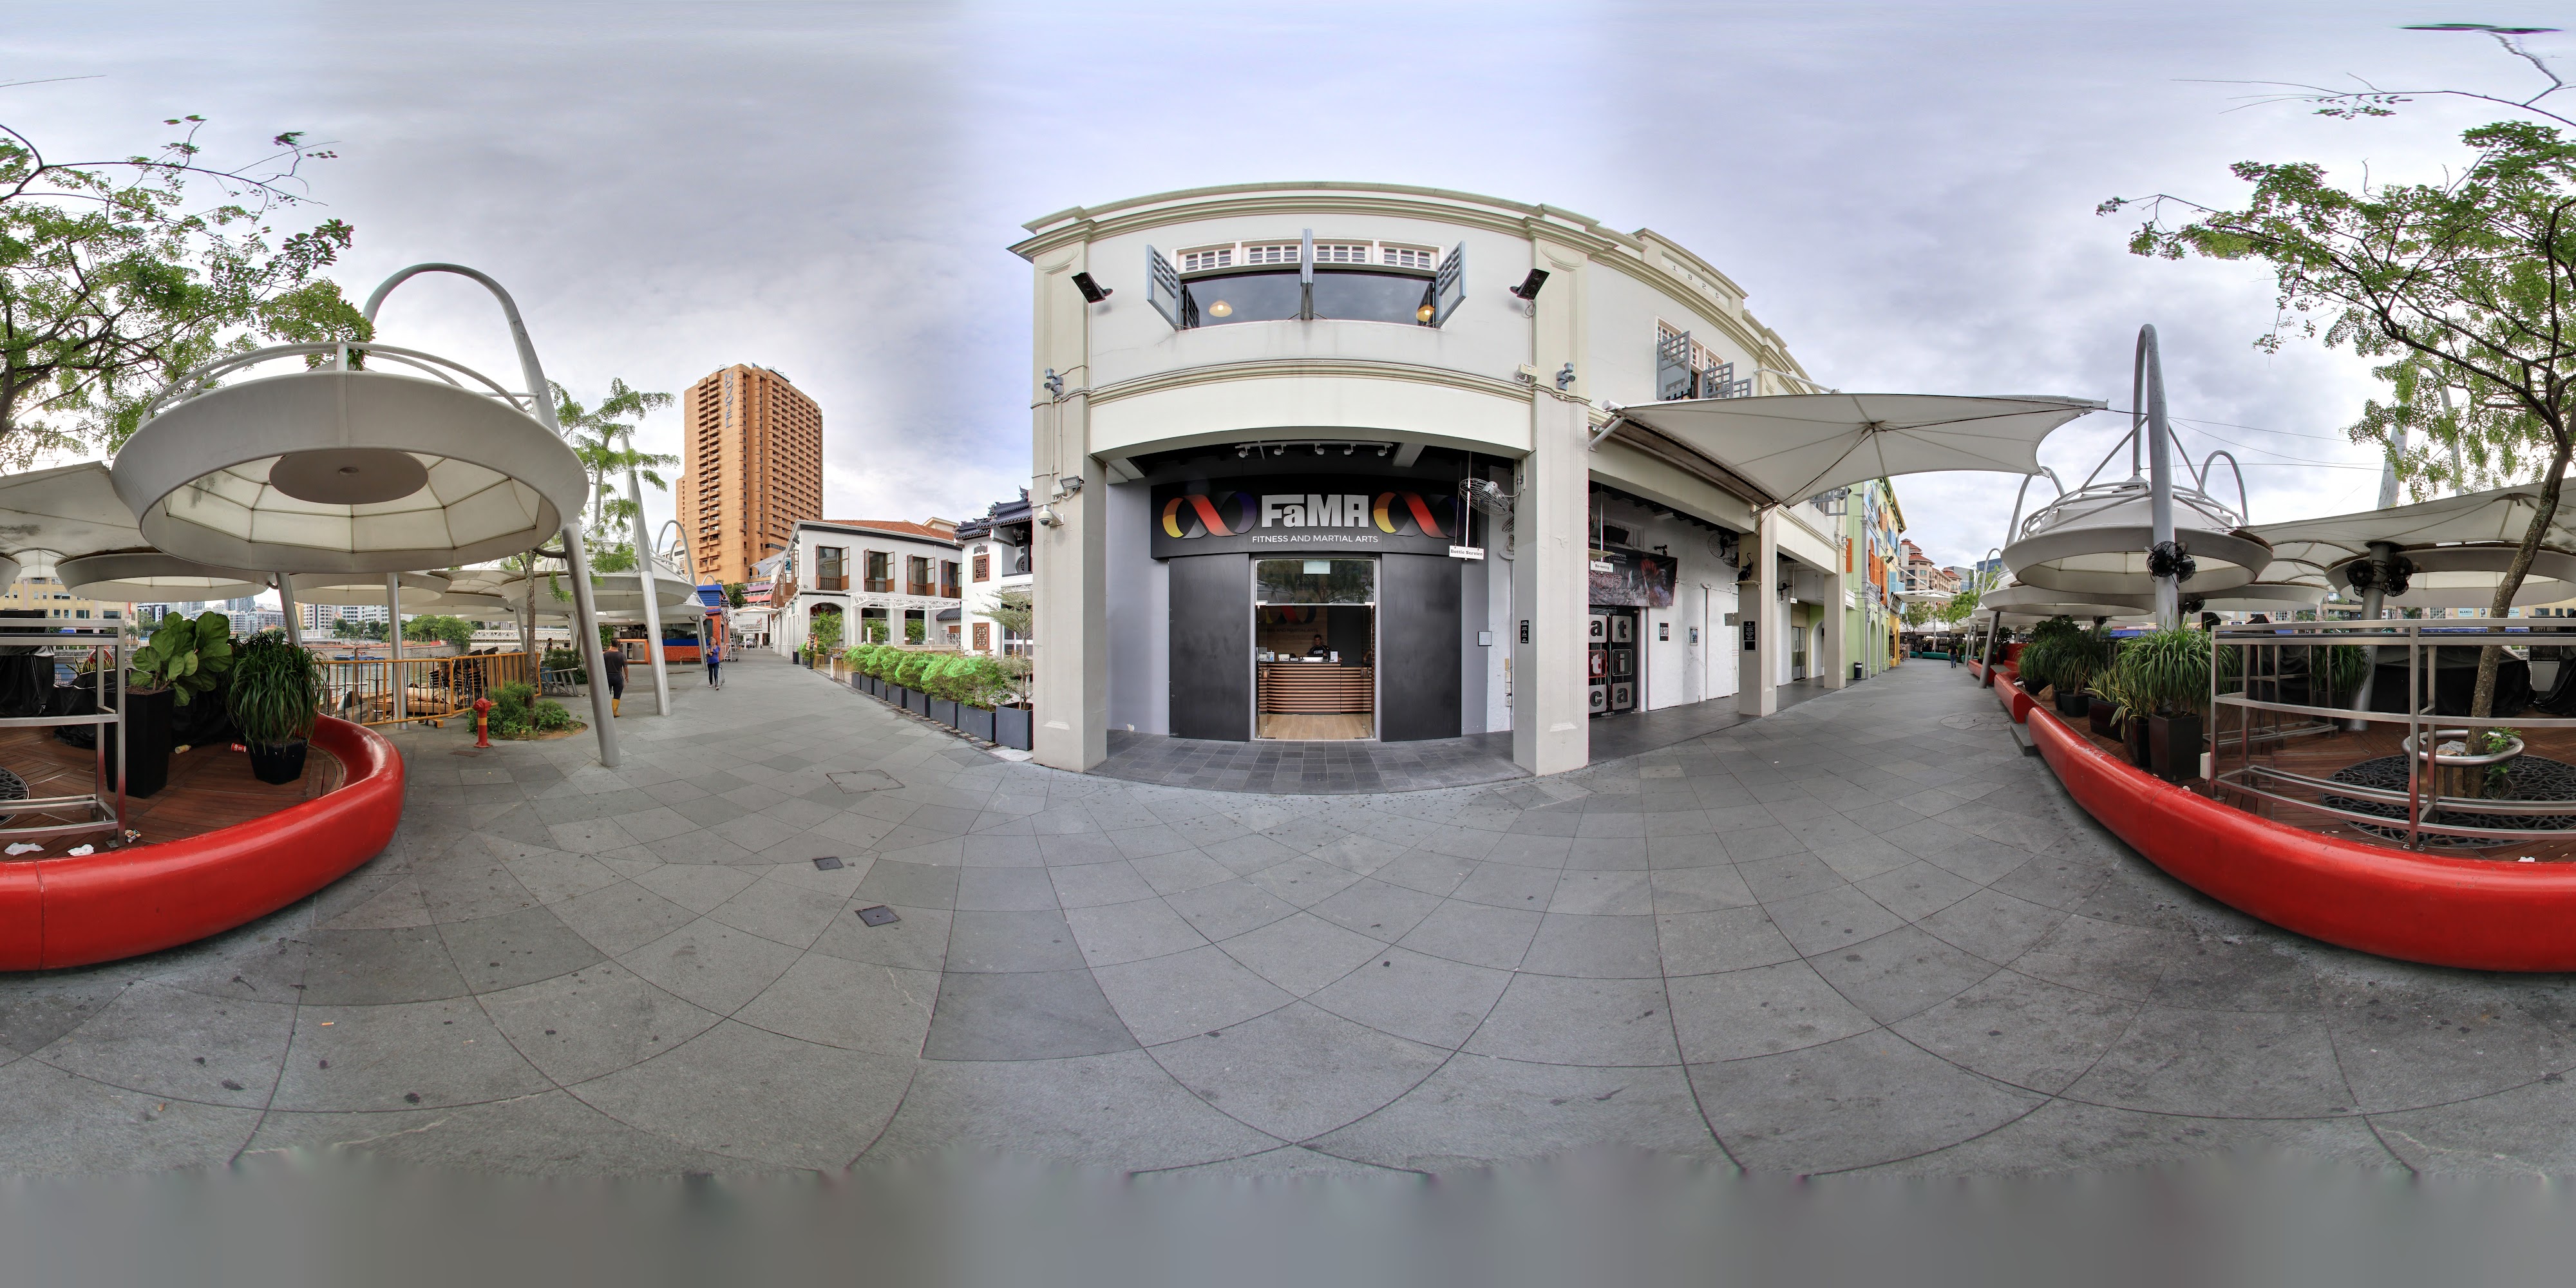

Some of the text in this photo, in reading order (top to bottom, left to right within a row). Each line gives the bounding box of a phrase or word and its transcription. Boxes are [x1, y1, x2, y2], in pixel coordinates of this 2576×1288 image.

[1672, 265, 1719, 299] 1825
[724, 371, 734, 428] NOVOTEL
[1262, 494, 1368, 527] FaMA
